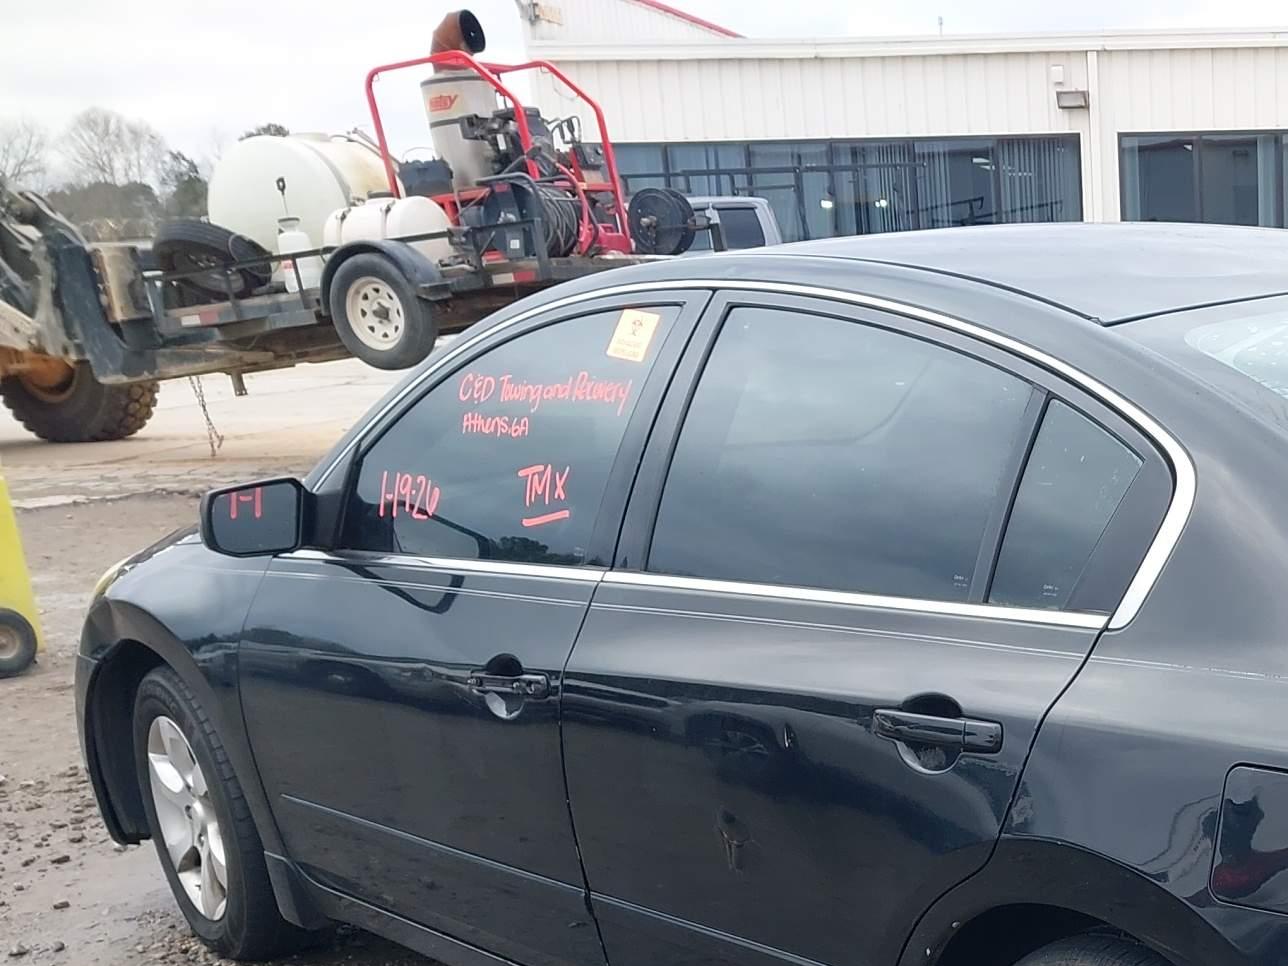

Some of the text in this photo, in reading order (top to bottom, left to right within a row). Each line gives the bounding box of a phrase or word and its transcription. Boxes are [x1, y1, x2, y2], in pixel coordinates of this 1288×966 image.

[500, 374, 542, 413] Towing
[543, 376, 573, 400] and
[573, 370, 633, 417] Recovery
